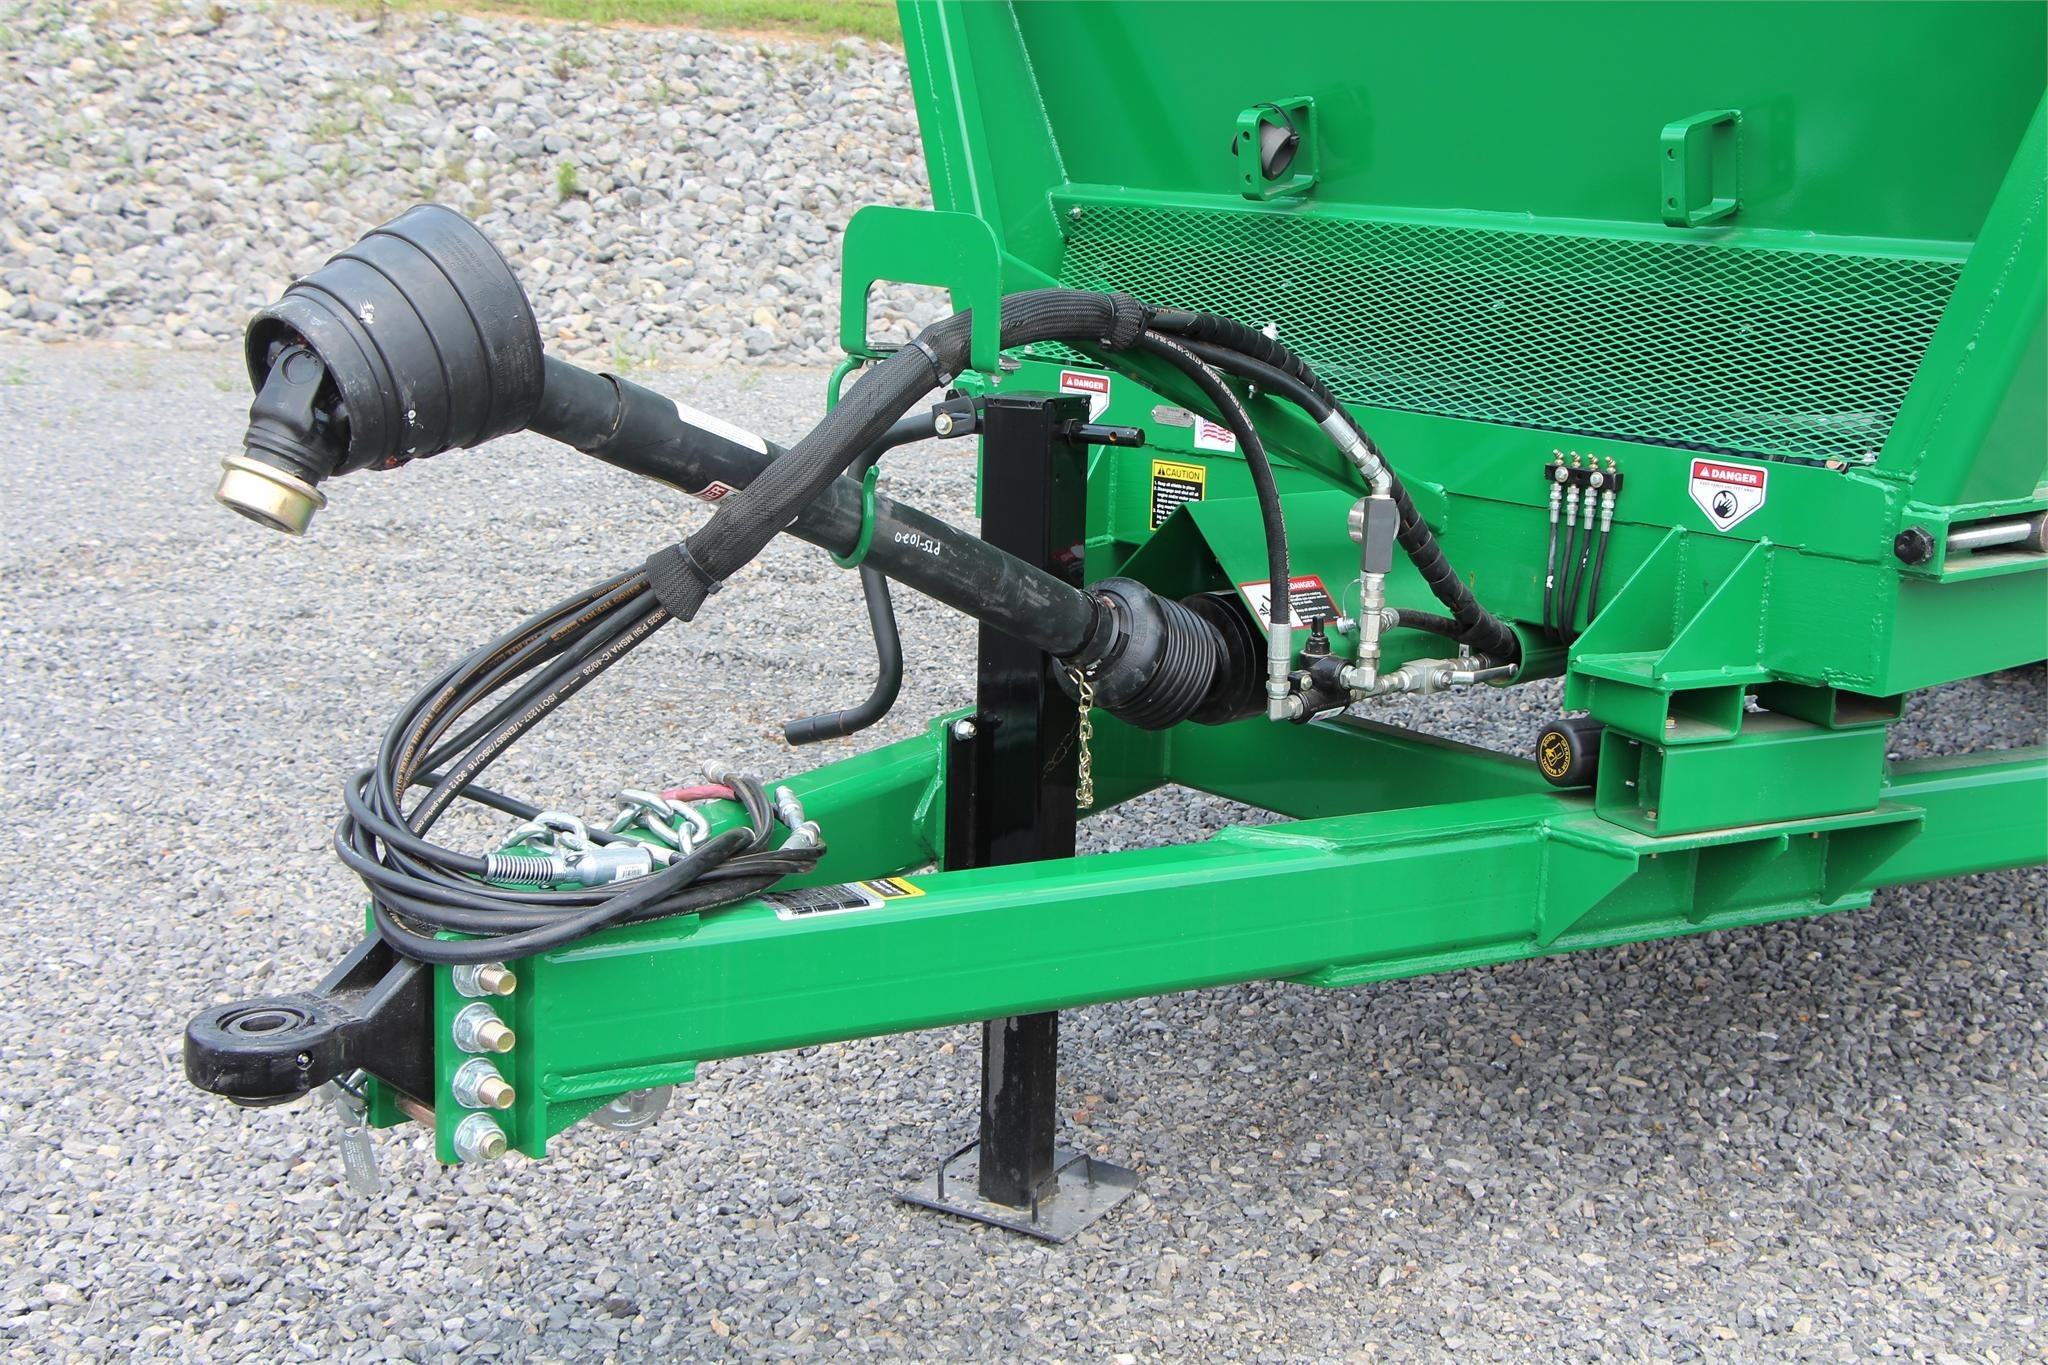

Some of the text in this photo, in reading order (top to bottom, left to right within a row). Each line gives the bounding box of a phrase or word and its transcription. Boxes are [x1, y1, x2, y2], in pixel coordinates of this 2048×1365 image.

[1073, 378, 1104, 390] DANGER
[1165, 467, 1200, 480] CAUTION
[1711, 468, 1757, 484] DANGER
[894, 531, 941, 556] PTS-1020
[582, 608, 668, 676] (3625 PSI) MSHA IC-40/26
[448, 770, 468, 789] 3Q12
